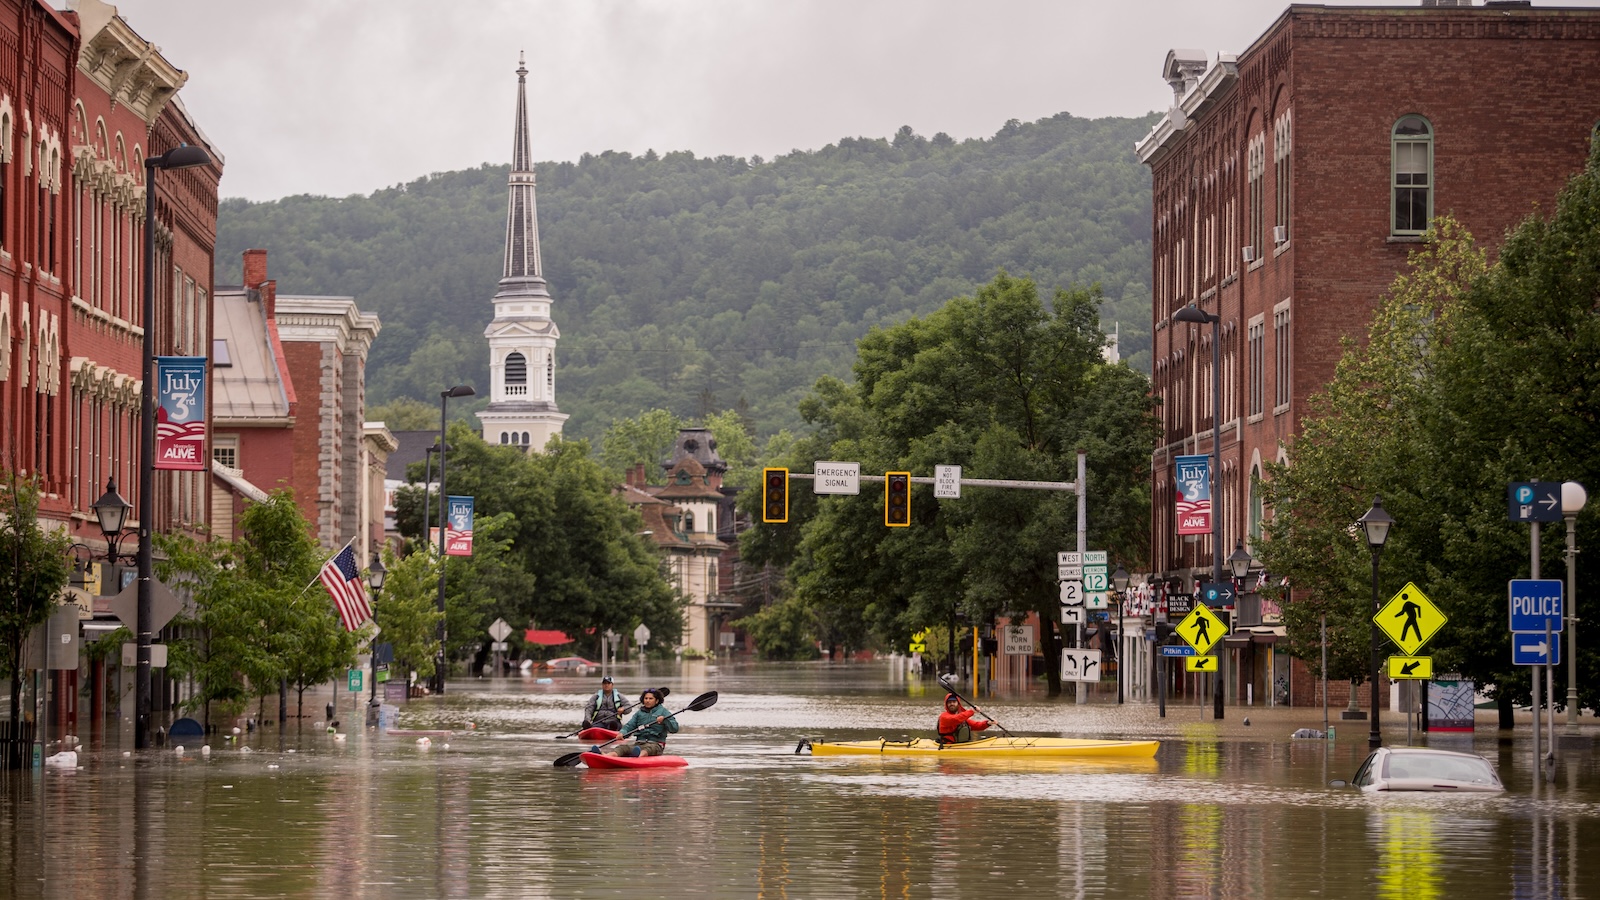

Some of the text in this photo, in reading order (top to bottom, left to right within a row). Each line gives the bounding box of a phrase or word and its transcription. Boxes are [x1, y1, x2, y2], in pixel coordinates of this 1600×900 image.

[162, 374, 201, 396] July
[171, 393, 196, 420] 3rd
[164, 448, 195, 459] ALIVE
[817, 469, 857, 477] EMERGENCY
[1179, 467, 1206, 483] July
[825, 479, 848, 487] SIGNAL
[1185, 480, 1203, 500] 3rd
[450, 504, 471, 518] July
[1183, 519, 1205, 527] ALIVE
[1062, 554, 1079, 562] WEST
[1084, 553, 1105, 561] NORTH
[1088, 575, 1103, 589] 12
[1067, 585, 1076, 599] 2
[1513, 596, 1560, 616] POLICE
